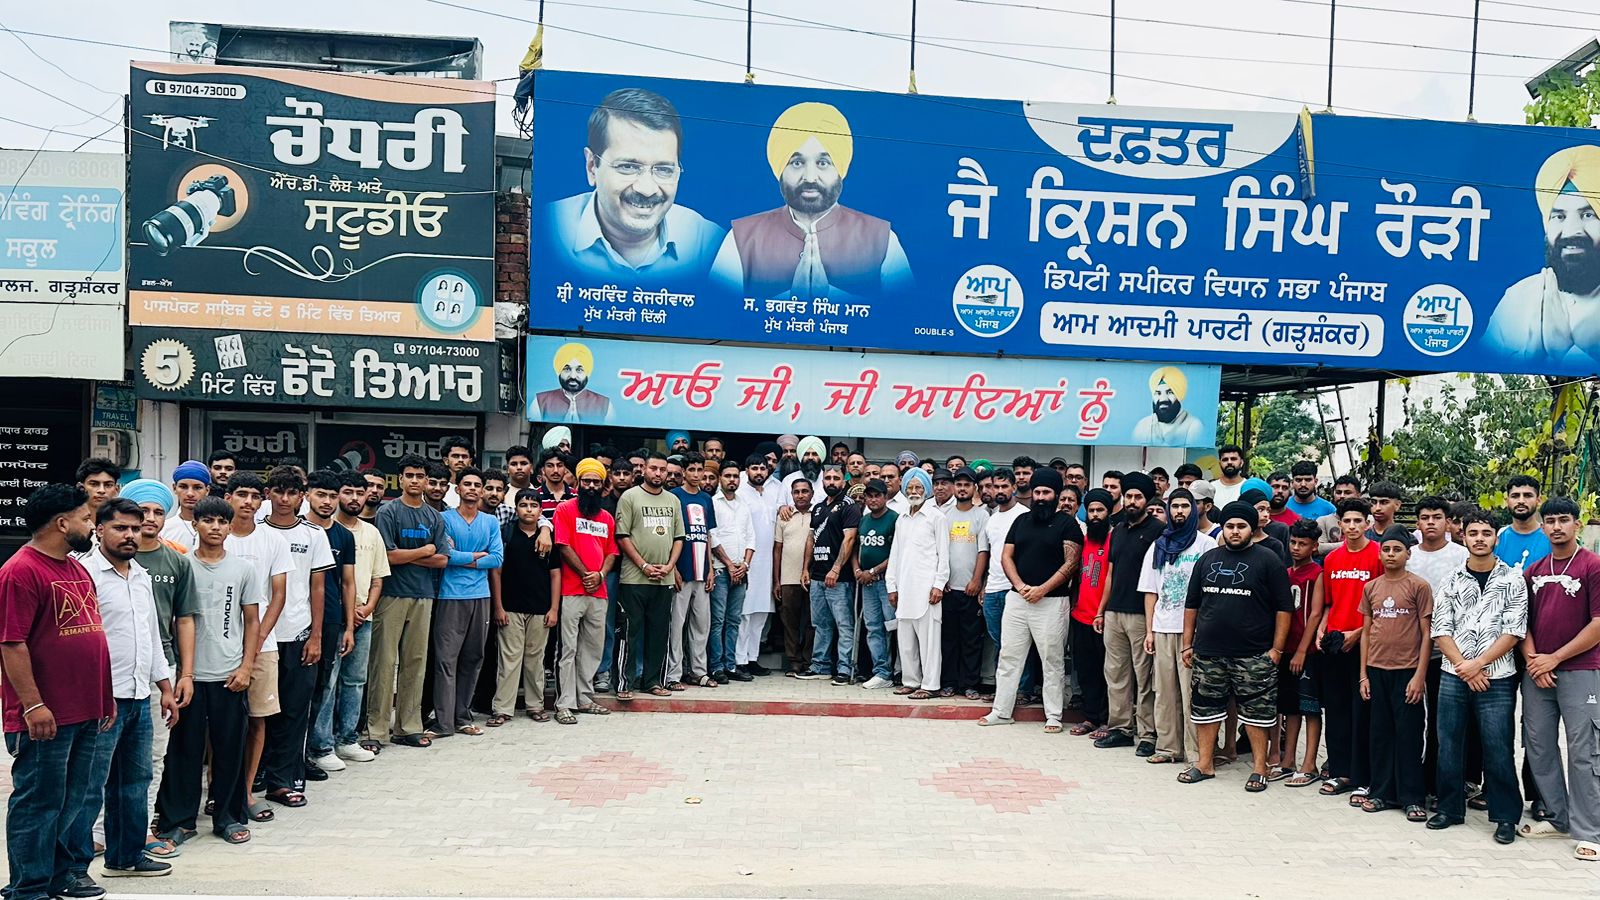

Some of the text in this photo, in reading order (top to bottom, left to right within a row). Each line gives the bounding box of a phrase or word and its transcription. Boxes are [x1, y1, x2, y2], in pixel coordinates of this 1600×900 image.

[169, 84, 237, 97] 97104-73000
[266, 96, 470, 173] ਚੌਧਰੀ
[1077, 116, 1233, 168] ਦਫ਼ਤਰ
[329, 174, 352, 192] ਲੈਬ
[358, 177, 383, 194] ਅਤੇ
[58, 193, 118, 231] ਟ੍ਰੇਨਿੰਗ
[304, 191, 449, 250] ਸਟੂਡੀਓ
[947, 157, 1491, 266] ਜੈ ਕ੍ਰਿਸ਼ਨ ਸਿੰਘ ਰੌੜੀ
[6, 238, 58, 268] ਸਕੂਲ
[48, 276, 121, 298] ਗੜ੍ਹਸ਼ੰਕਰ
[966, 276, 1011, 307] ਆਪ
[1044, 261, 1388, 303] ਡਿਪਟੀ ਸਪੀਕਰ ਵਿਧਾਨ ਸਭਾ ਪੰਜਾਬ
[578, 284, 628, 303] ਅਰਵਿੰਦ
[633, 287, 696, 308] ਕੇਜਰੀਵਾਲ
[743, 296, 871, 318] ਸ. ਭਗਵੰਤ ਸਿੰਘ ਮਾਨ
[143, 297, 200, 314] ਪਾਸਪੋਰਟ
[252, 300, 274, 318] ਫੋਟੋ
[279, 305, 290, 320] 5
[296, 302, 323, 321] ਮਿੰਟ
[328, 304, 354, 321] ਵਿੱਚ
[359, 306, 402, 324] ਤਿਆਰ
[584, 305, 667, 324] ਮੁੱਖ ਮੰਤਰੀ ਦਿੱਲੀ
[975, 317, 1000, 329] ਪੰਜਾਬ
[1417, 295, 1462, 326] ਆਪ
[764, 317, 849, 335] ਮੁੱਖ ਮੰਤਰੀ ਪੰਜਾਬ
[914, 327, 955, 337] DOUBLE-S
[1053, 310, 1370, 352] ਆਮ ਆਦਮੀ ਪਾਰਟੀ (ਗੜ੍ਹਸ਼ੰਕਰ)
[409, 344, 480, 358] 97104-73000
[1424, 335, 1450, 349] ਪੰਜਾਬ
[155, 348, 180, 385] 5
[201, 372, 235, 395] ਮਿੰਟ
[242, 374, 277, 397] ਵਿੱਚ
[281, 343, 337, 397] ਫੋਟੋ
[350, 348, 484, 403] ਤਿਆਰ
[620, 362, 1114, 437] ਆਓ ਜੀ, ਜੀ ਆਇਆਂ ਨੂੰ
[102, 411, 129, 421] TRAVEL
[24, 427, 49, 436] ਕਾਰਡ
[223, 428, 297, 454] ਚੌਧਰੀ
[642, 506, 673, 517] LAKERS
[1201, 586, 1252, 597] NDER ARMOUR
[223, 585, 234, 640] ARMOUR
